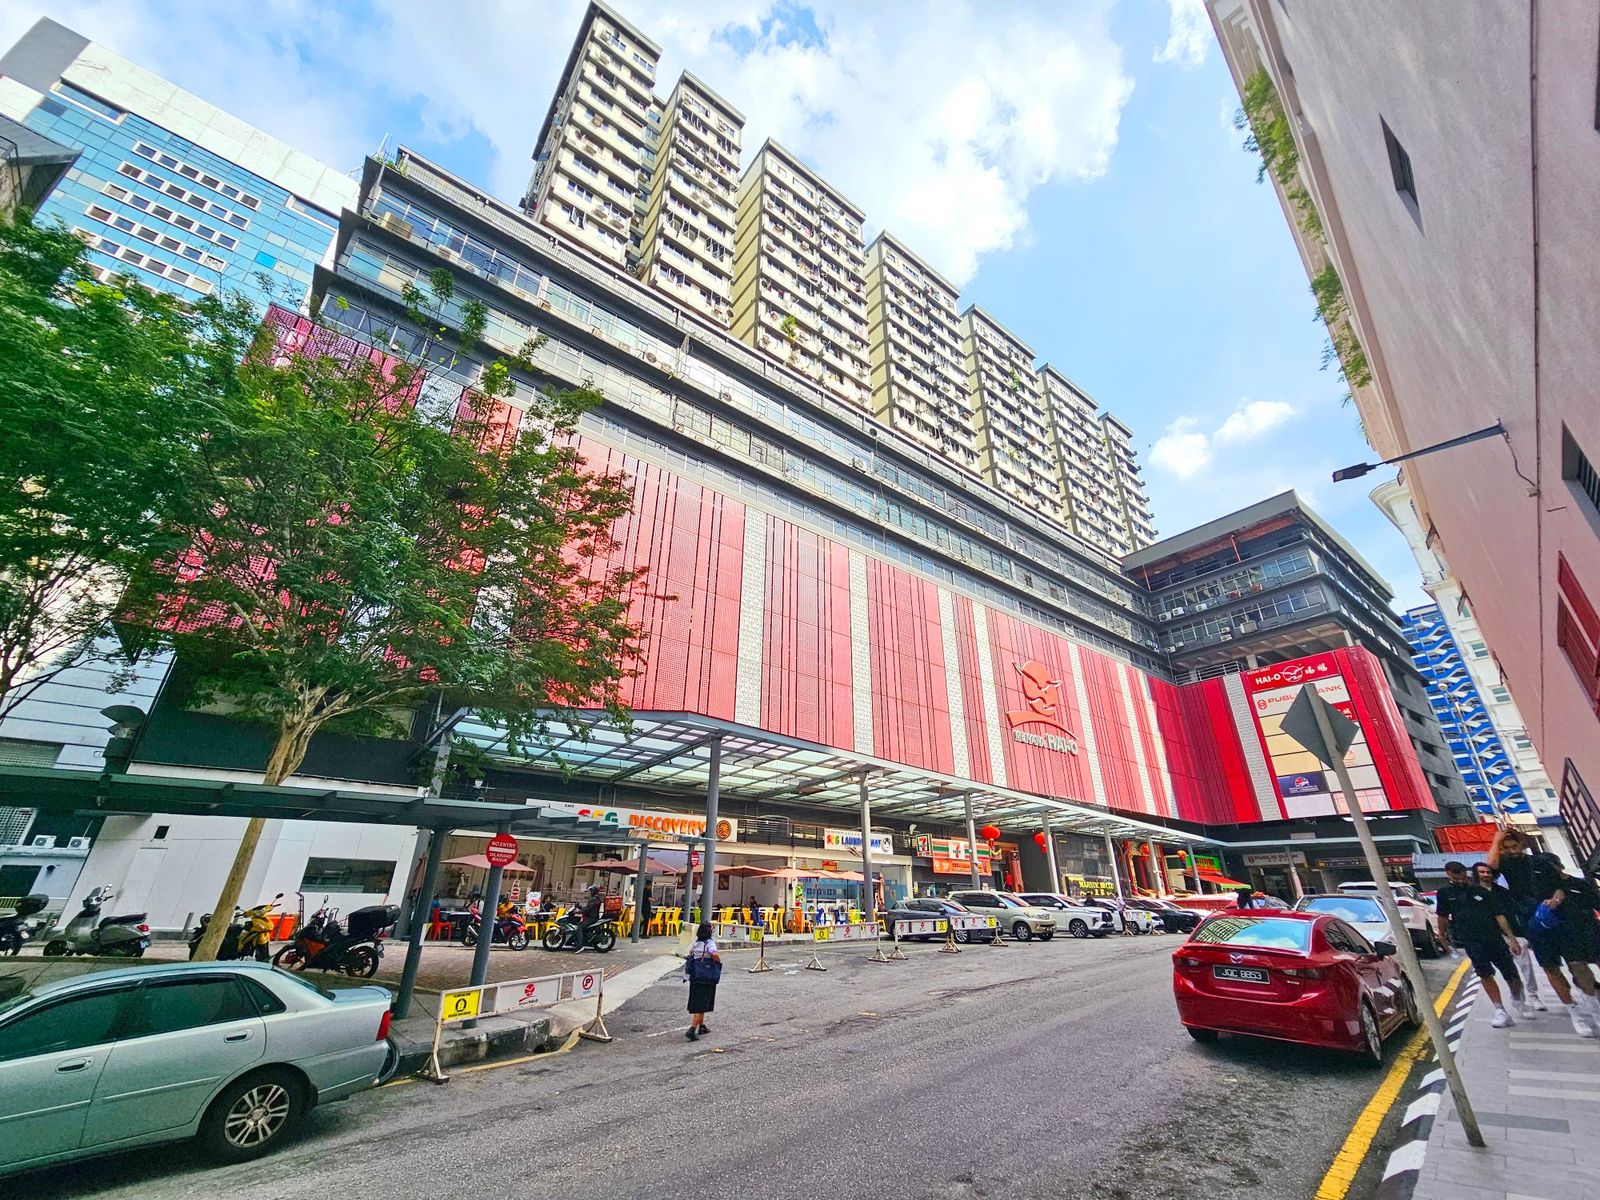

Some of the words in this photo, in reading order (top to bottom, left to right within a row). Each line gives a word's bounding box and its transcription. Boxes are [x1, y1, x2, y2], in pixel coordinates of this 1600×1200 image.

[1255, 673, 1281, 684] HAI-O
[1268, 694, 1296, 703] PUBL
[1318, 684, 1342, 694] ANK
[629, 814, 706, 836] DISCOVERY
